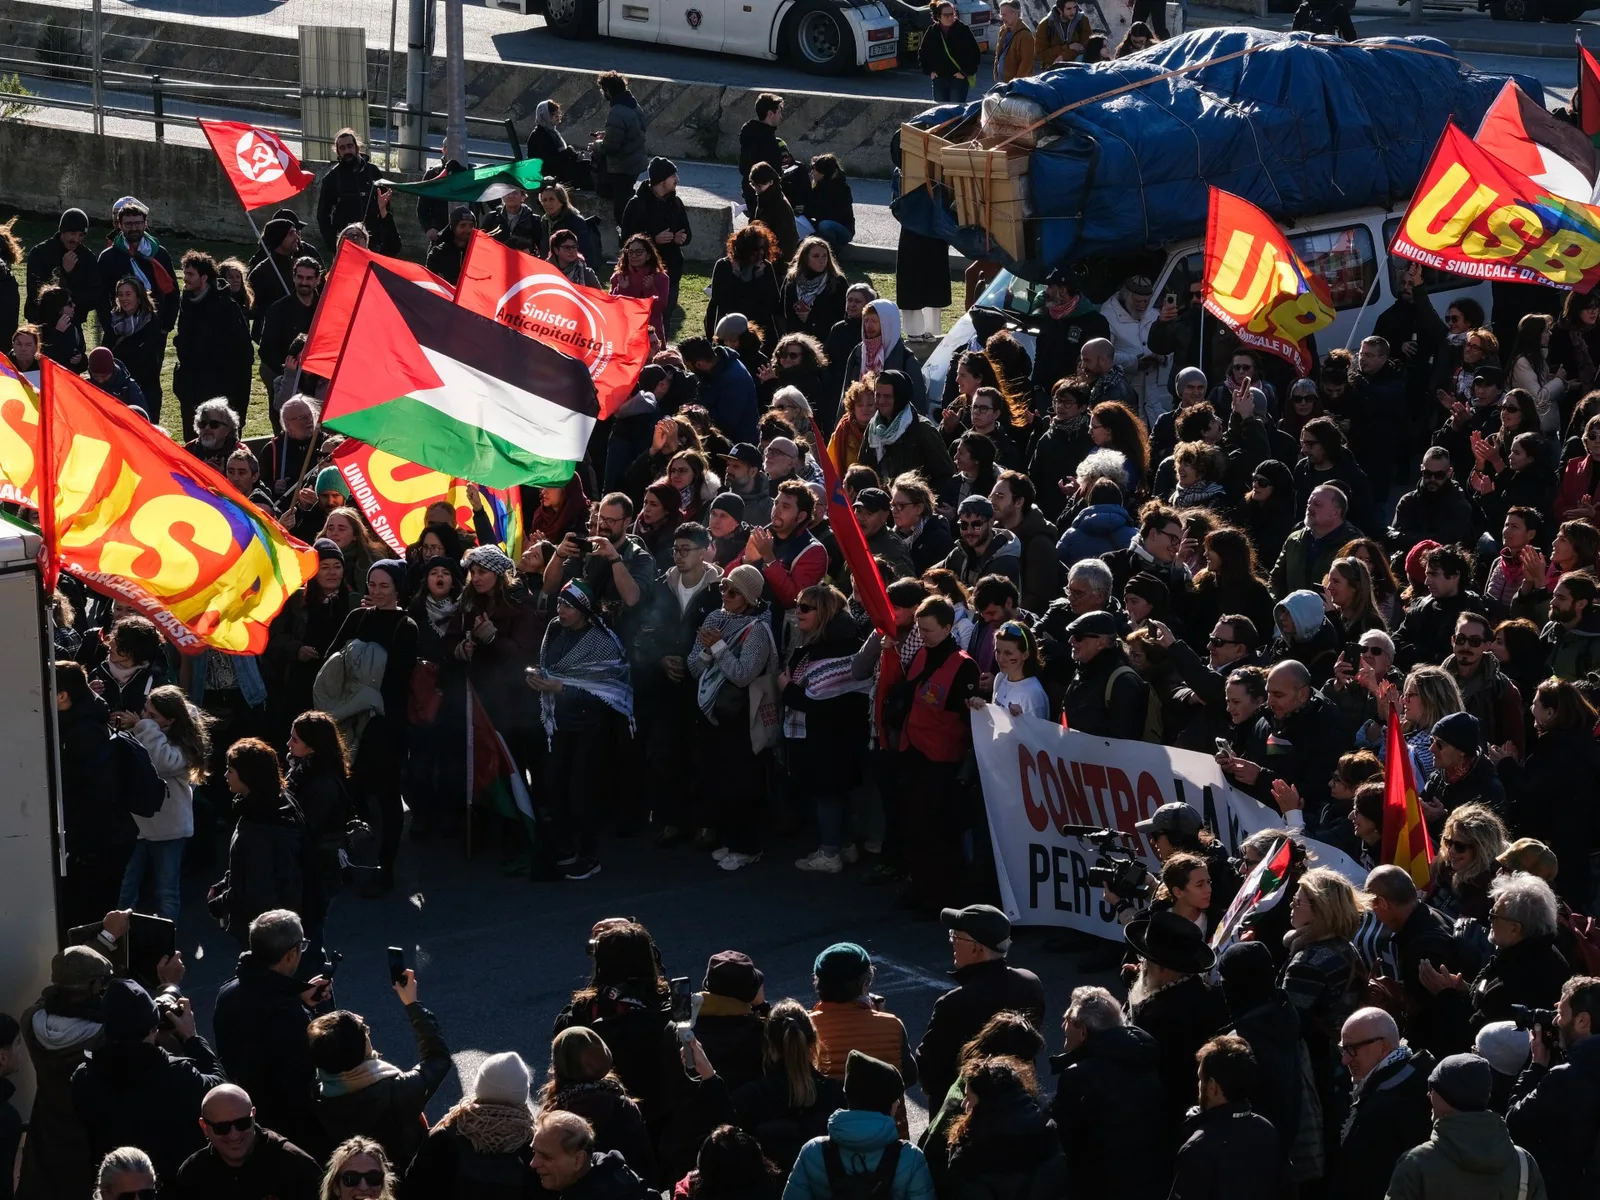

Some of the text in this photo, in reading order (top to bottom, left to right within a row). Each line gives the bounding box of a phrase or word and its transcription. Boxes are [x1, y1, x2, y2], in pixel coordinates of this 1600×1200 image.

[1406, 162, 1600, 284] USB
[1394, 239, 1445, 268] UNIONE
[1445, 259, 1518, 279] SINDACALE
[1519, 268, 1534, 281] DI
[496, 307, 603, 352] Anticapitalista
[520, 302, 578, 331] Sinistra
[1282, 344, 1293, 358] DI
[343, 462, 382, 517] UNIONE
[153, 610, 200, 647] BASE
[1018, 743, 1165, 862] CONTRO
[1029, 843, 1091, 917] PER
